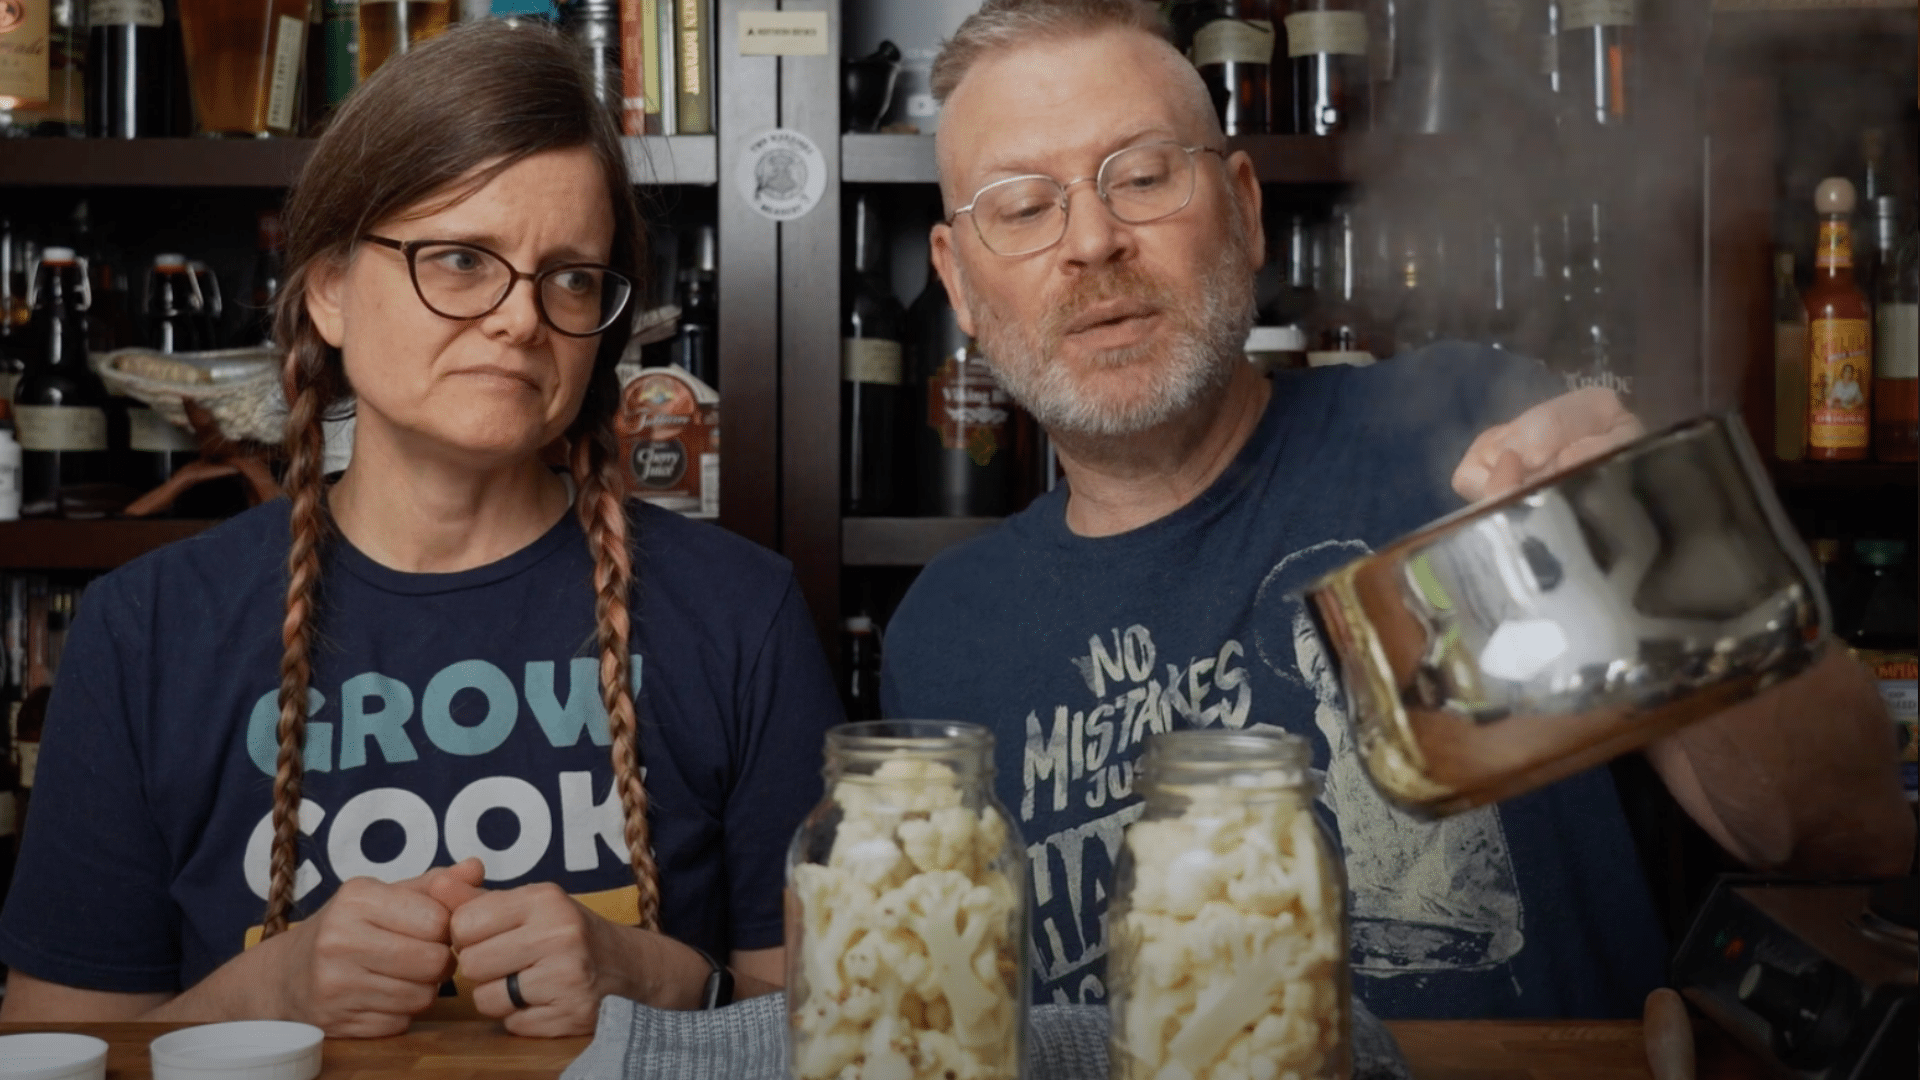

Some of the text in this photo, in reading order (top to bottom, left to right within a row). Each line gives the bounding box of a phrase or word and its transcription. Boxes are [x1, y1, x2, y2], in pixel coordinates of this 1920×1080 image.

[246, 654, 643, 778] GROW
[1088, 623, 1156, 698] NO
[1020, 639, 1252, 823] MISTAKES
[243, 766, 648, 902] COOK
